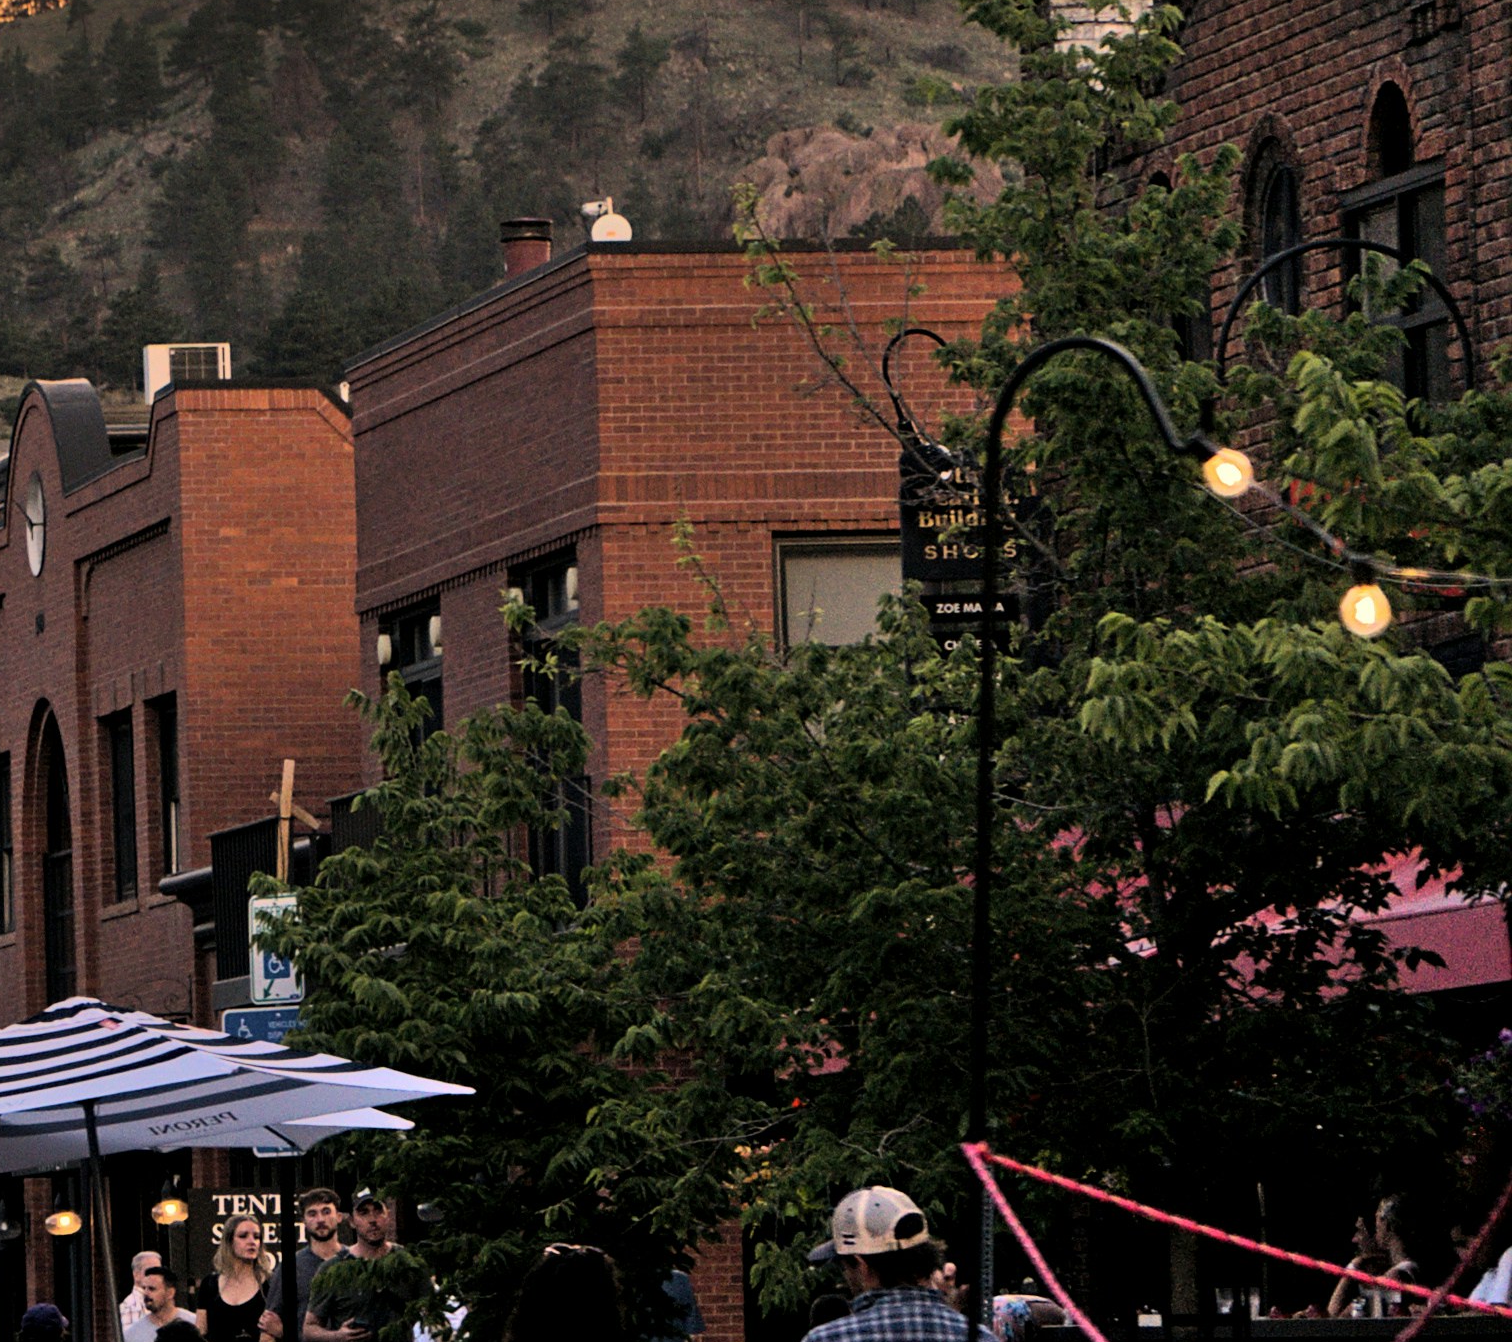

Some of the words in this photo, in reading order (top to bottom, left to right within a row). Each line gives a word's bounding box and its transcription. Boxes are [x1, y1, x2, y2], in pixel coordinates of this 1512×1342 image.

[918, 510, 1017, 531] Buildig
[924, 541, 1017, 560] SHOS
[936, 603, 961, 614] ZOE
[213, 1194, 300, 1216] TENT
[212, 1222, 308, 1245] SET
